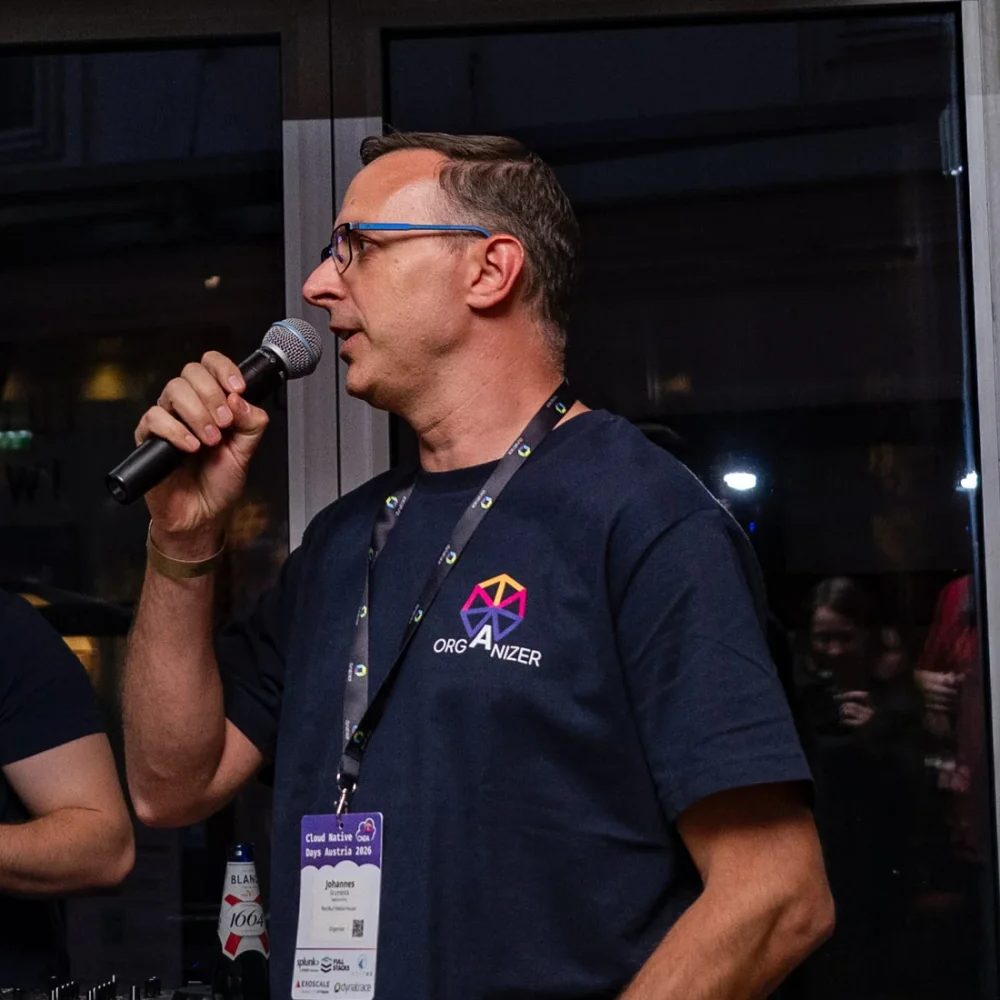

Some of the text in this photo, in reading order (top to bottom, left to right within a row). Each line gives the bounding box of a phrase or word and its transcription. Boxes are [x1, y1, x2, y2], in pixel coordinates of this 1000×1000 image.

[433, 624, 542, 667] ORGANIZER
[305, 831, 353, 843] Cloud Native
[305, 845, 372, 859] Days Austria 2026
[231, 875, 259, 884] BLAN
[324, 879, 355, 890] Johannes
[230, 909, 264, 928] 1664
